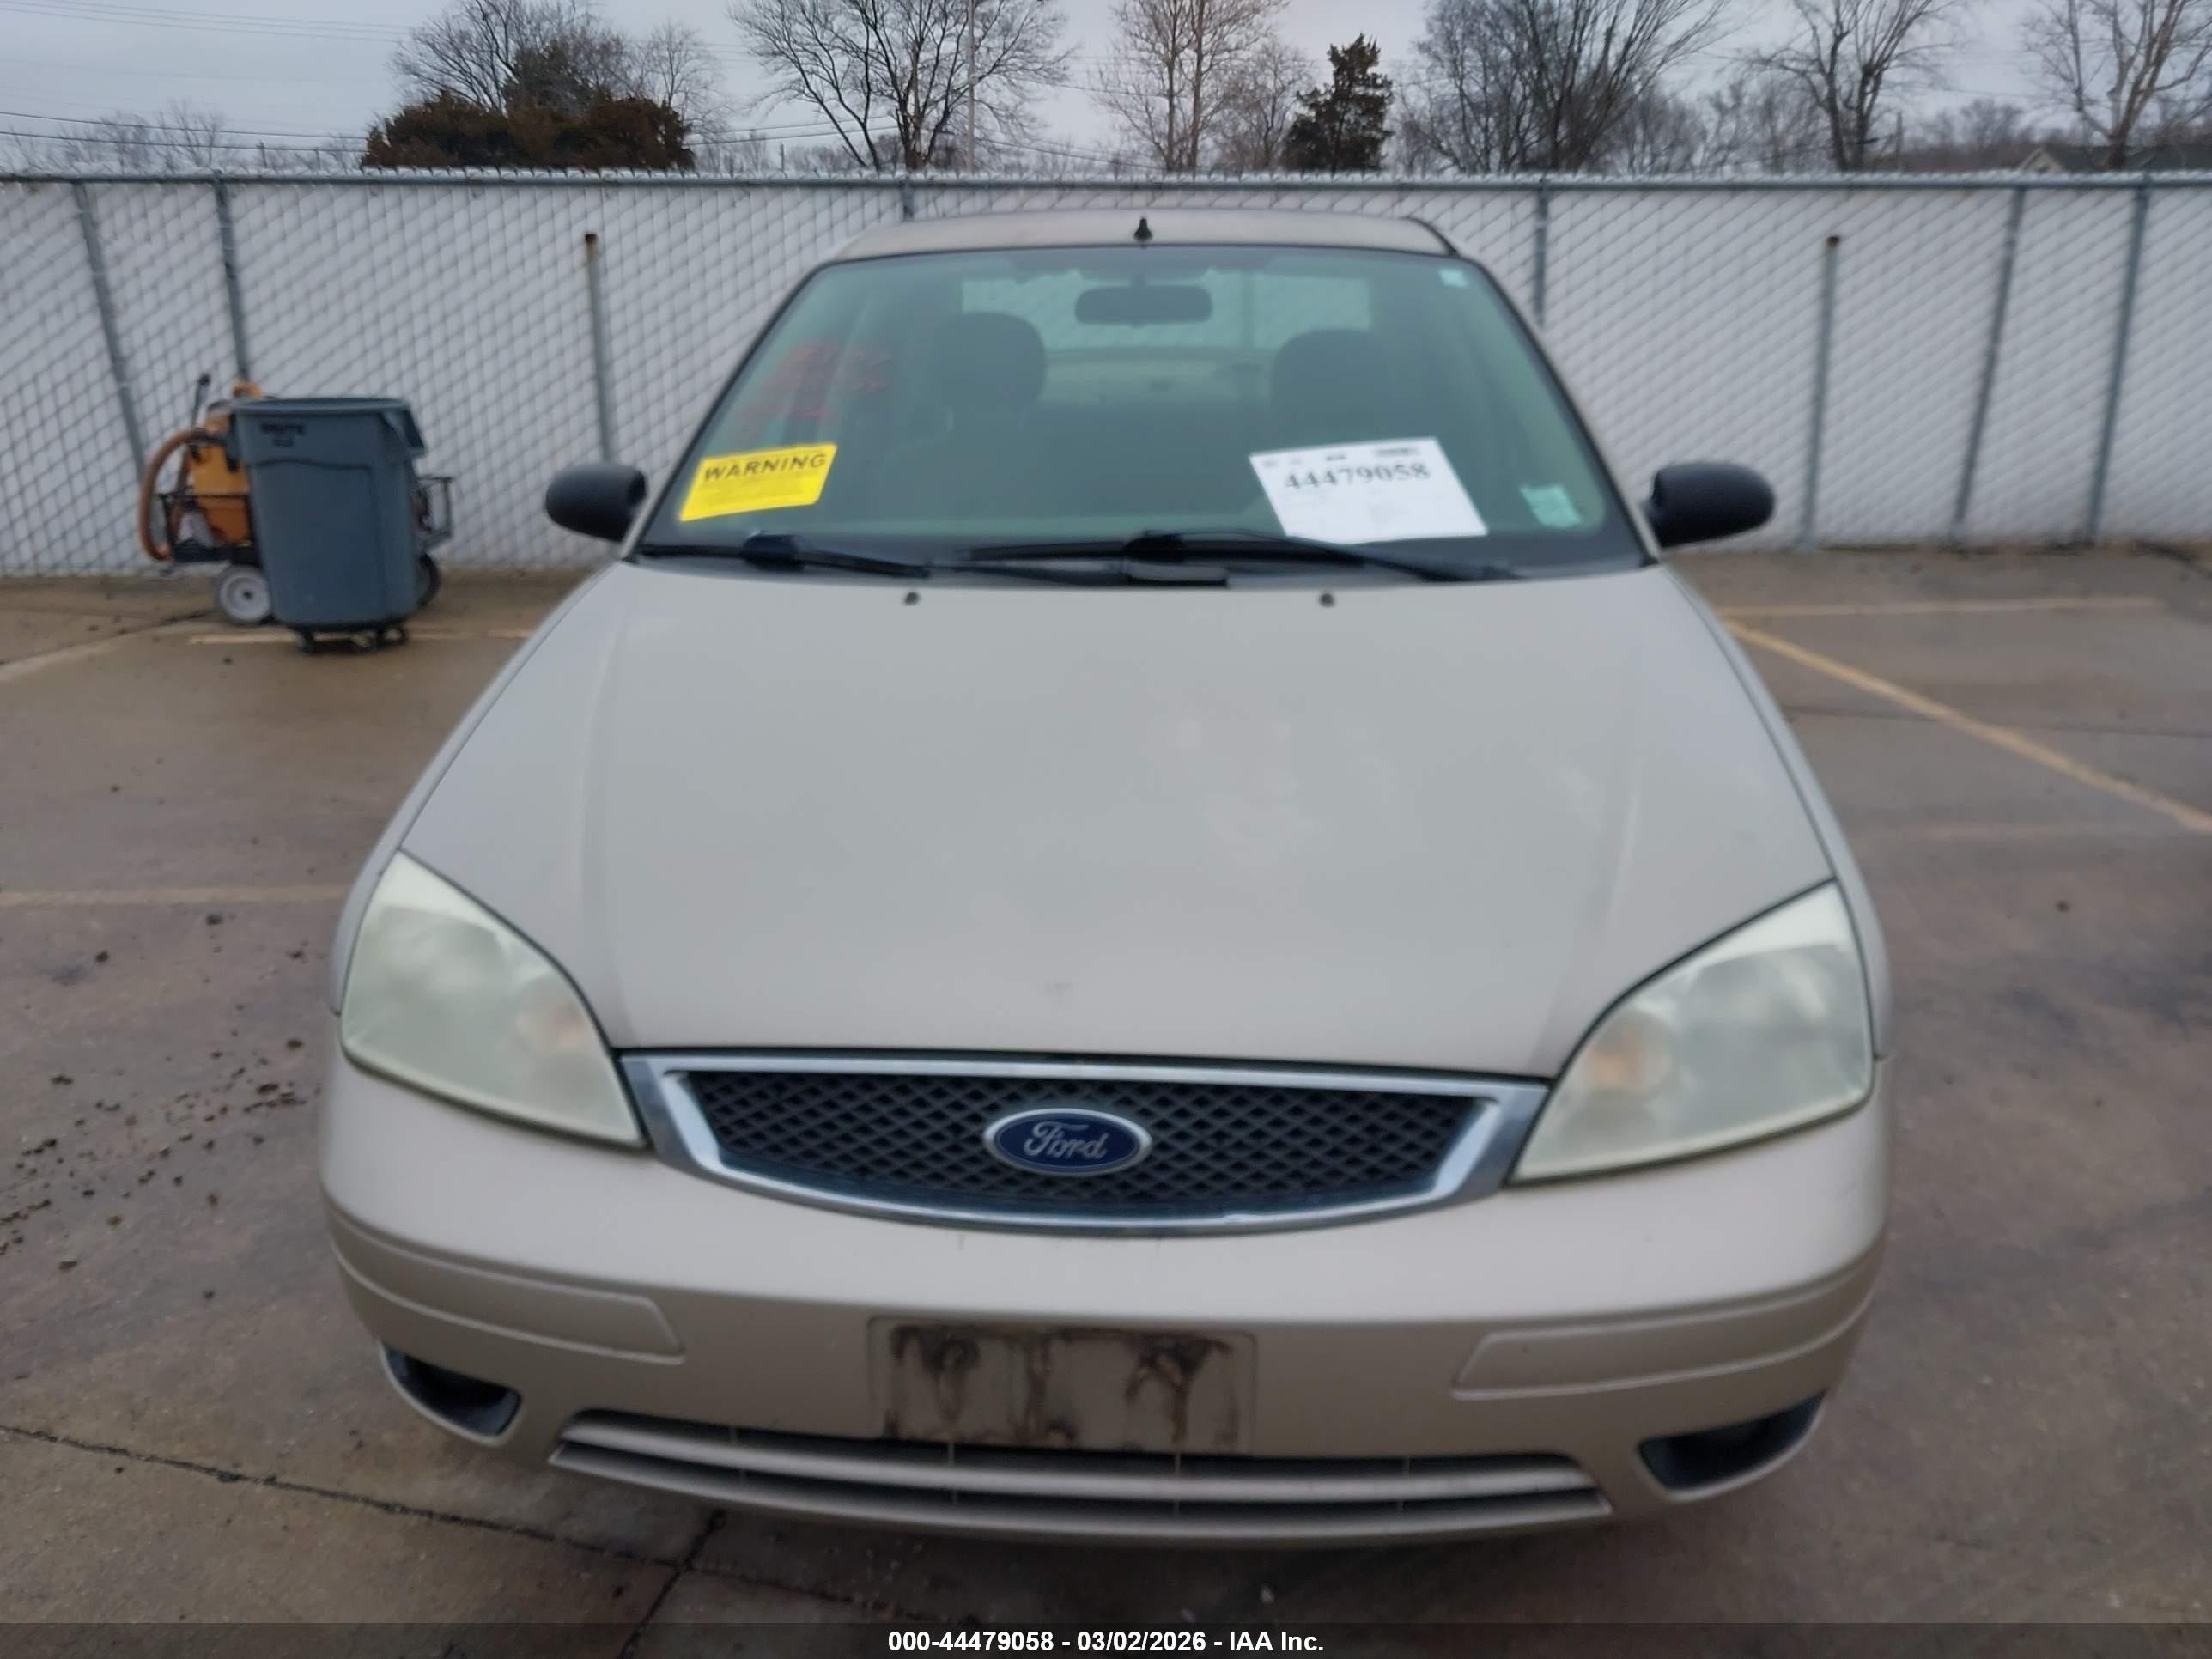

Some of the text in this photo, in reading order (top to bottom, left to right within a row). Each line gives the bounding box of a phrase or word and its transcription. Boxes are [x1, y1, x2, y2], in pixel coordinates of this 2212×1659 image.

[704, 453, 827, 483] WARNING
[1285, 461, 1430, 489] 44479058
[1024, 1121, 1109, 1159] Ford
